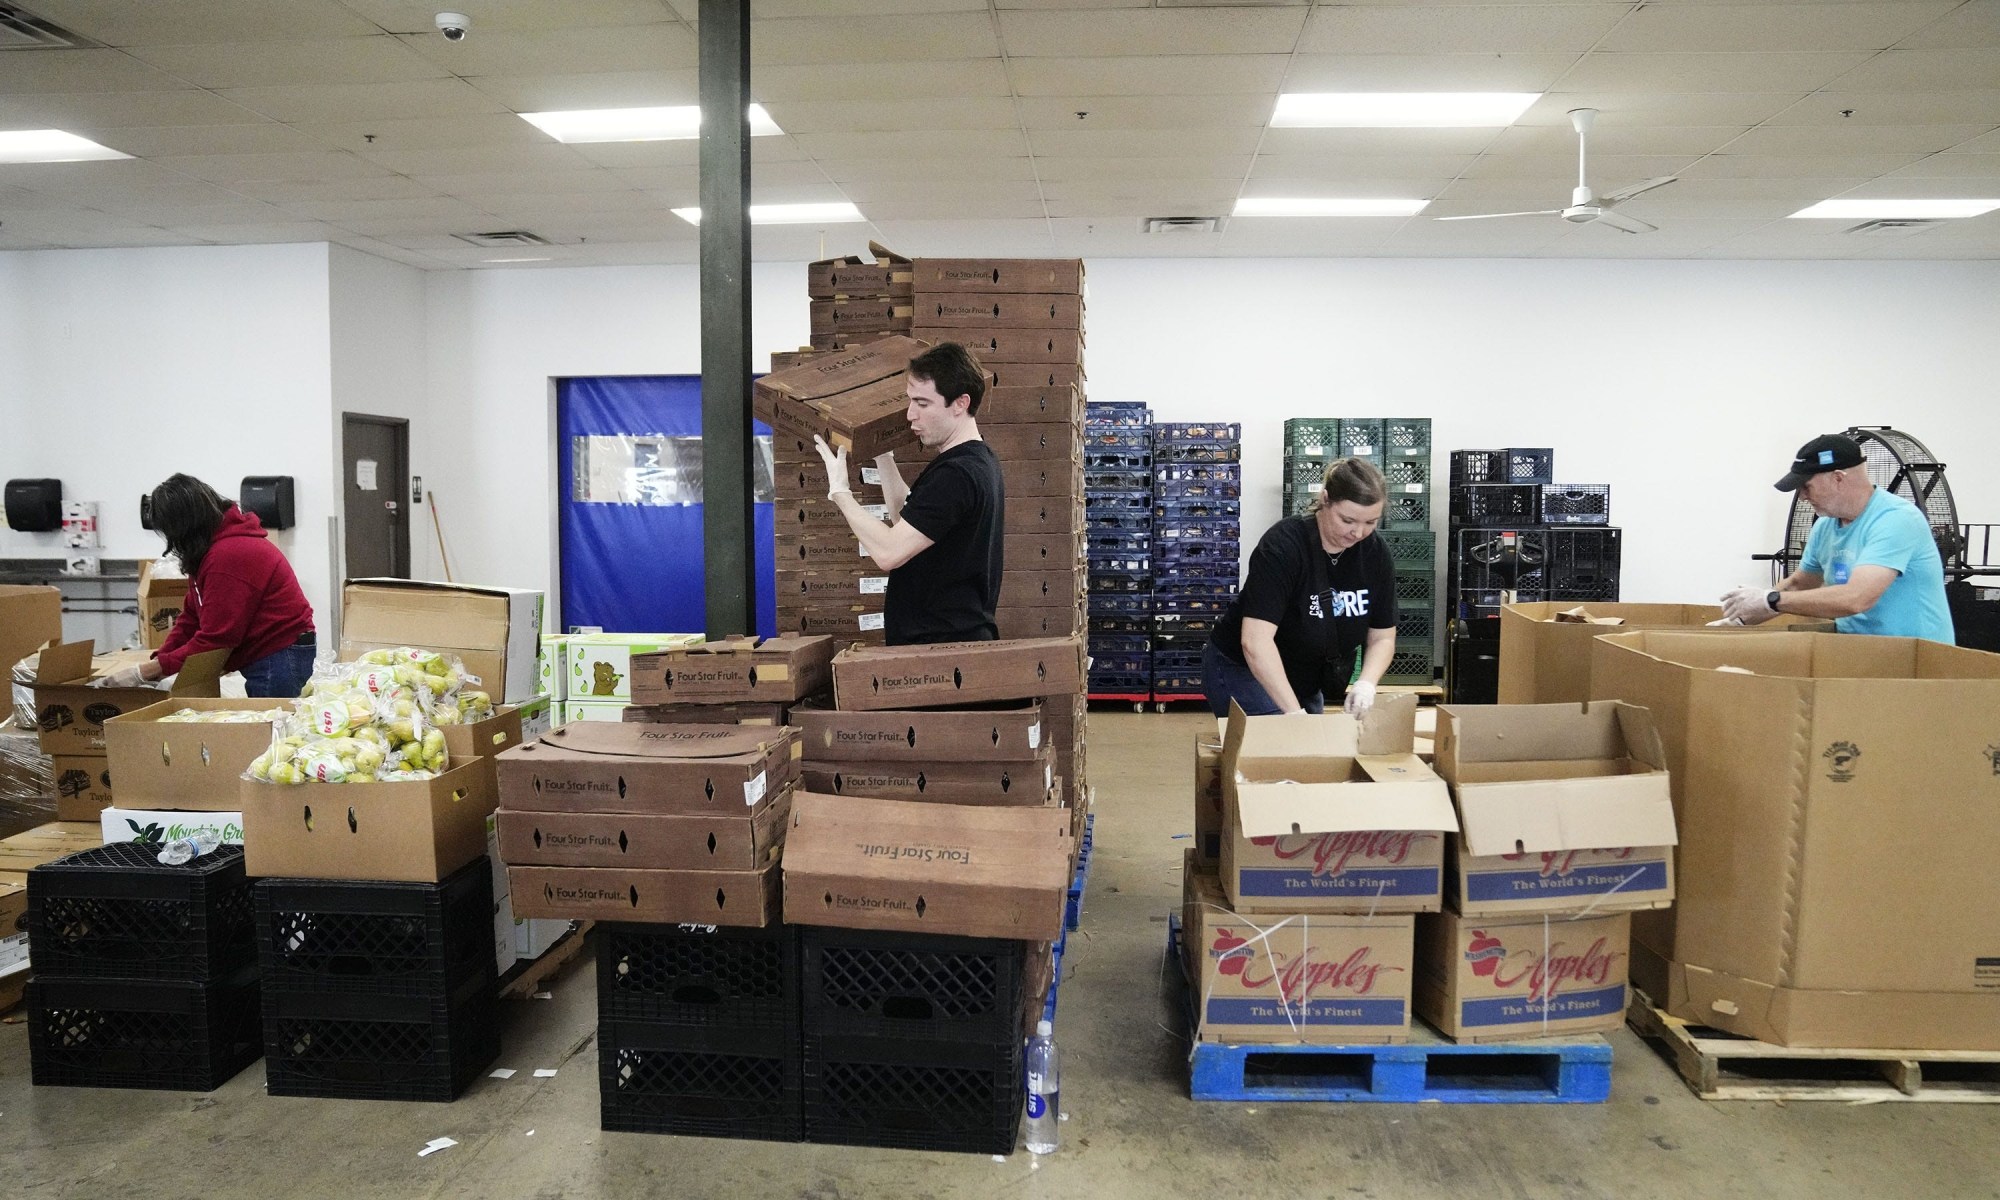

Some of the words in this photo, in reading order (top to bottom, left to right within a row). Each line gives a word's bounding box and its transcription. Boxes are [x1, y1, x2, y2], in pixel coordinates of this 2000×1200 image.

[839, 274, 852, 282] Four
[853, 274, 865, 282] Star
[865, 274, 878, 282] Fruit
[945, 271, 957, 279] Four
[958, 271, 970, 279] Star
[971, 271, 988, 279] Fruit
[840, 311, 853, 320] Four
[854, 311, 866, 319] Star
[866, 311, 881, 319] Fruit
[943, 306, 956, 315] Four
[957, 306, 970, 315] Star
[971, 306, 987, 315] Fruit
[817, 363, 837, 373] Four
[837, 358, 855, 368] Star
[855, 351, 877, 363] Fruit
[780, 408, 794, 421] Four
[793, 414, 806, 427] Star
[805, 420, 818, 432] Fruit
[368, 673, 378, 692] USA
[677, 671, 696, 682] Four
[697, 671, 716, 681] Star
[717, 670, 738, 681] Fruit
[882, 677, 902, 687] Four
[903, 676, 921, 686] Star
[923, 674, 946, 685] Fruit
[324, 711, 333, 733] USA
[72, 727, 100, 738] Taylor
[639, 731, 669, 739] Four
[672, 731, 697, 739] Star
[698, 731, 730, 739] Fruit
[837, 731, 856, 741] Four
[858, 731, 876, 741] Star
[878, 732, 899, 741] Fruit
[545, 779, 565, 790] Four
[566, 780, 586, 791] Star
[587, 781, 610, 792] Fruit
[846, 777, 866, 787] Four
[867, 777, 887, 787] Star
[887, 777, 909, 787] Fruit
[546, 833, 566, 844] Four
[567, 833, 587, 845] Star
[588, 835, 611, 846] Fruit
[863, 845, 897, 859] Fruit
[901, 847, 934, 862] Star
[936, 849, 969, 864] Four
[1284, 878, 1307, 888] The
[1311, 877, 1356, 888] World's
[1358, 878, 1397, 888] Finest
[1512, 880, 1536, 890] The
[1538, 877, 1583, 889] World's
[1586, 873, 1625, 886] Finest
[556, 887, 577, 898] Four
[577, 888, 597, 899] Star
[598, 889, 621, 900] Fruit
[836, 894, 858, 905] Four
[860, 895, 881, 907] Star
[883, 897, 907, 910] Fruit
[1241, 945, 1405, 1006] Apples
[1493, 936, 1626, 1002] Apples
[1250, 1006, 1273, 1016] The
[1324, 1006, 1362, 1017] Finest
[1501, 1006, 1522, 1016] The
[1567, 998, 1600, 1010] Finest
